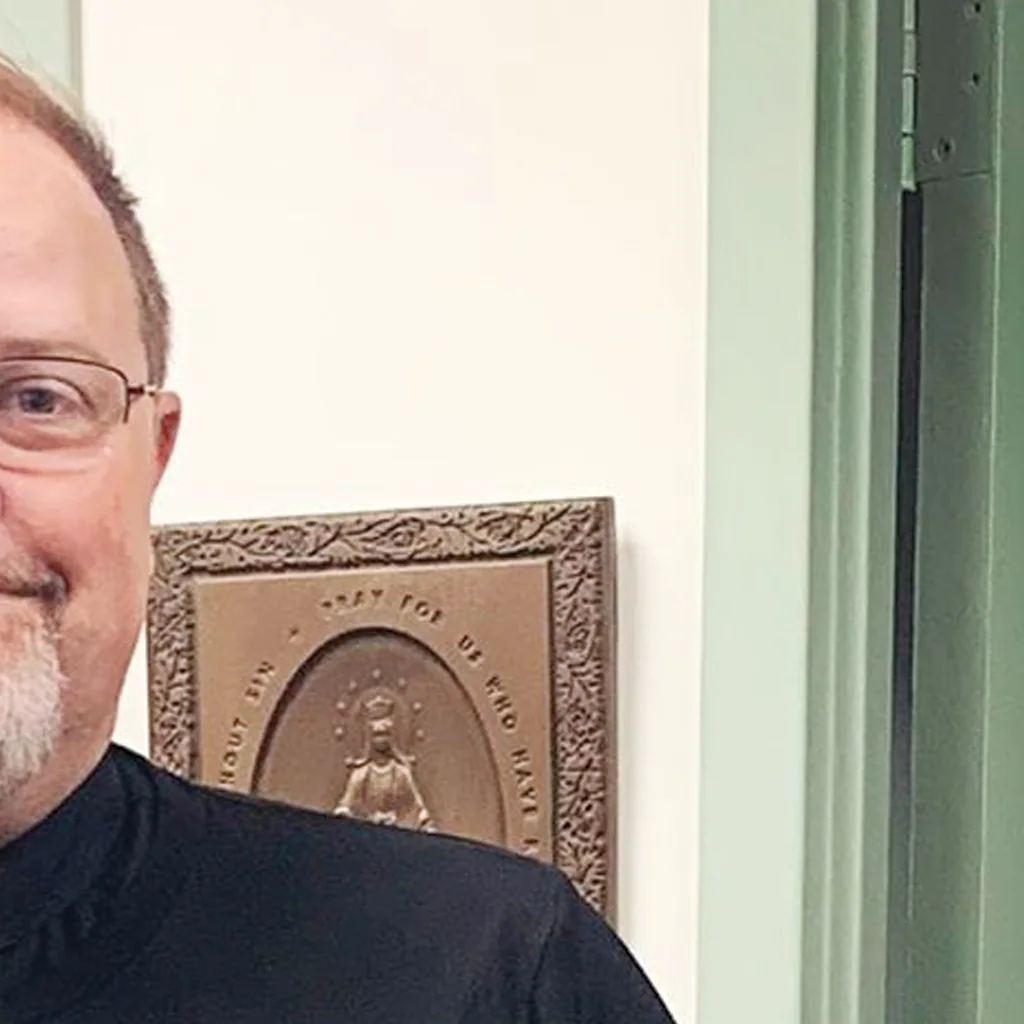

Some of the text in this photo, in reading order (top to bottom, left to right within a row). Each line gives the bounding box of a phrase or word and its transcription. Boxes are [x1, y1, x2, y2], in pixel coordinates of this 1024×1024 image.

[399, 593, 444, 626] FOR
[457, 633, 482, 663] US
[484, 675, 516, 730] WHO
[511, 748, 538, 820] HAVE
